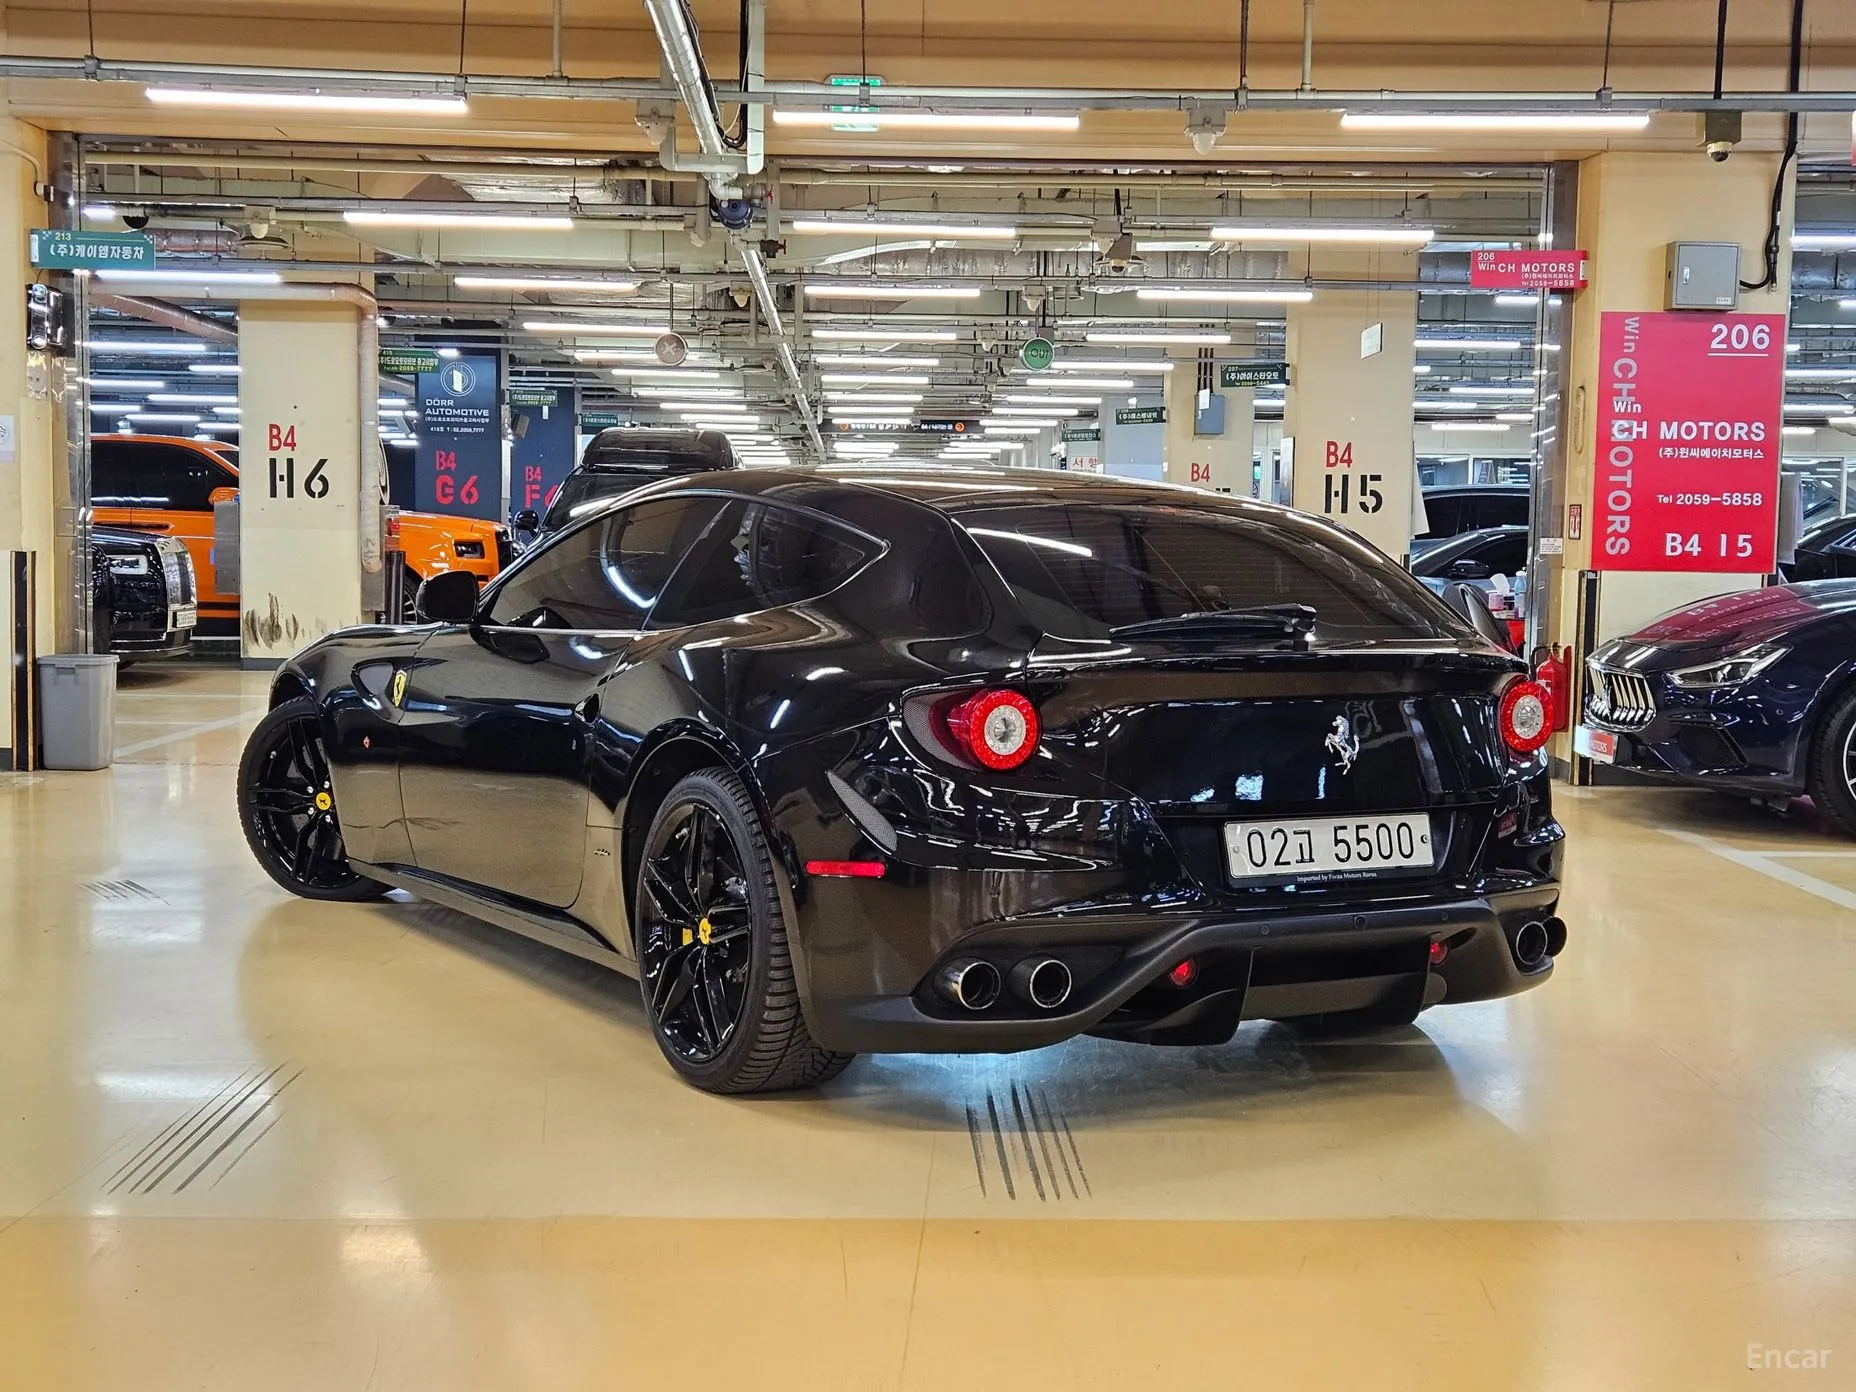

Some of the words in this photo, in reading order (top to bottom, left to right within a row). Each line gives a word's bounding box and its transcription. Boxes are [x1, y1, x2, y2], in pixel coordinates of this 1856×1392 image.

[55, 232, 72, 241] 213
[1477, 252, 1495, 260] 206
[1477, 262, 1496, 271] Win
[1498, 263, 1516, 273] CH
[1521, 263, 1575, 273] MOTORS
[1624, 316, 1640, 353] Win
[1710, 323, 1770, 350] 206
[1031, 348, 1049, 359] OUT
[425, 408, 490, 417] AUTOMOTIVE
[1613, 401, 1642, 413] Win
[268, 423, 297, 451] B4
[1612, 420, 1648, 440] CH
[1659, 421, 1765, 441] MOTORS
[436, 449, 456, 471] B4
[1325, 440, 1353, 468] B4
[525, 466, 542, 482] B4
[1191, 462, 1210, 482] B4
[1657, 494, 1673, 504] Tel
[1676, 492, 1763, 506] 2059-5858
[1665, 533, 1702, 557] B4
[1333, 821, 1415, 863] 5500
[1296, 874, 1321, 883] Imported
[1322, 874, 1328, 882] by
[1343, 872, 1363, 880] Motors
[1362, 871, 1378, 879] Korea
